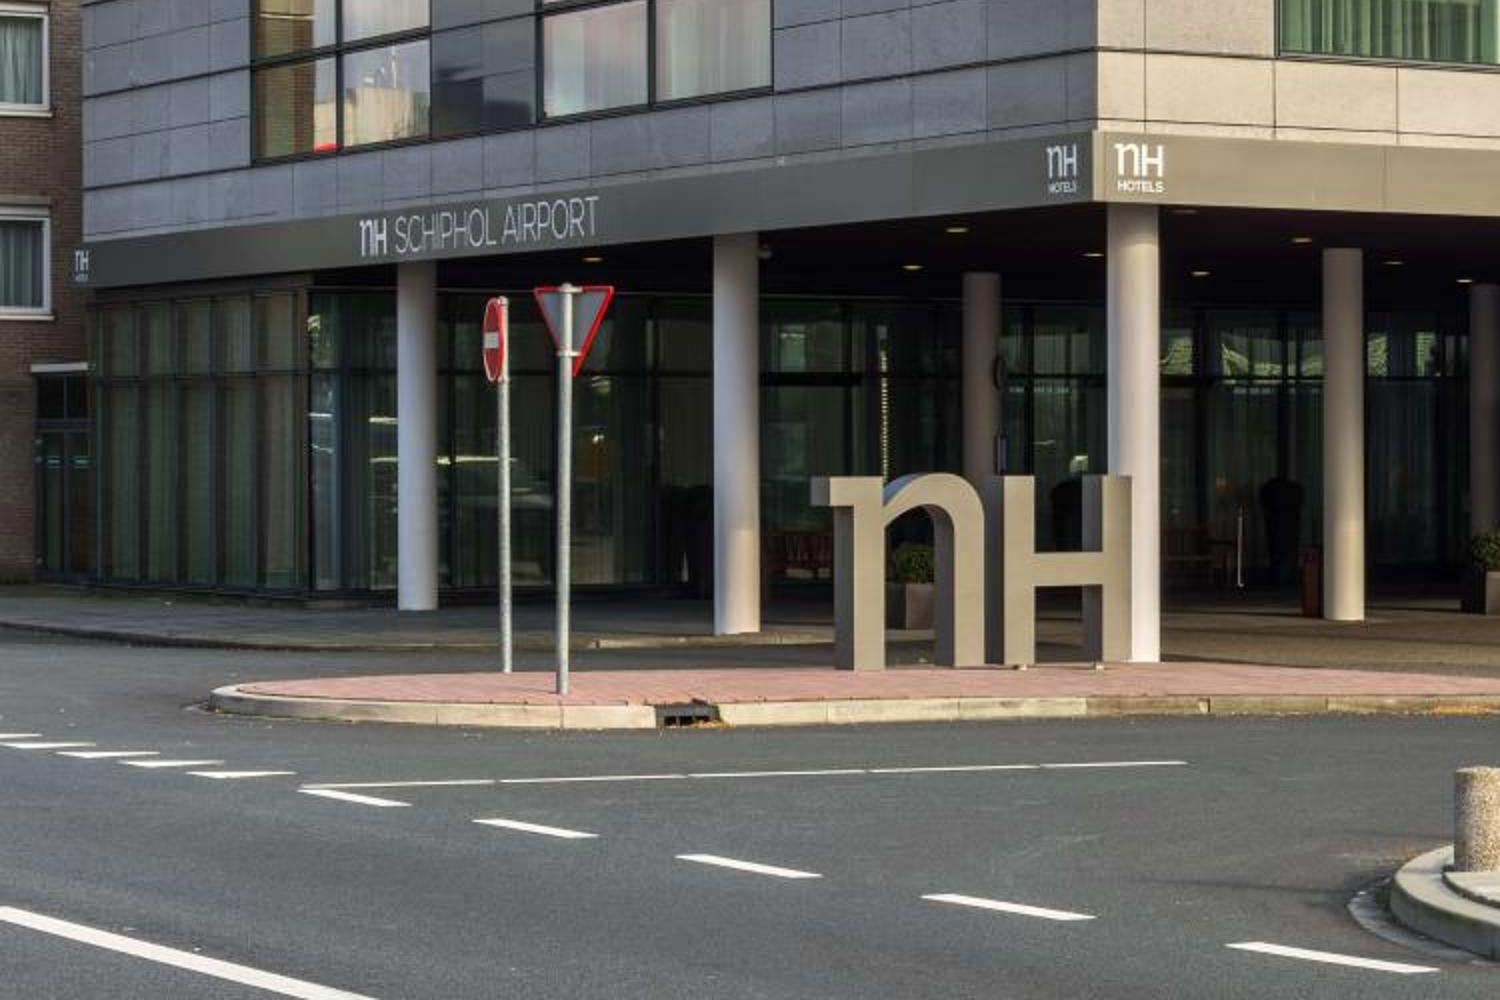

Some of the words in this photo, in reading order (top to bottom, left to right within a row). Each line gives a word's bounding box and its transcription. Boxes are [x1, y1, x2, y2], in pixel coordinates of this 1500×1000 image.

[1117, 180, 1166, 194] HOTELS
[394, 207, 497, 255] SCHIPHOL
[501, 195, 600, 244] AIRPORT
